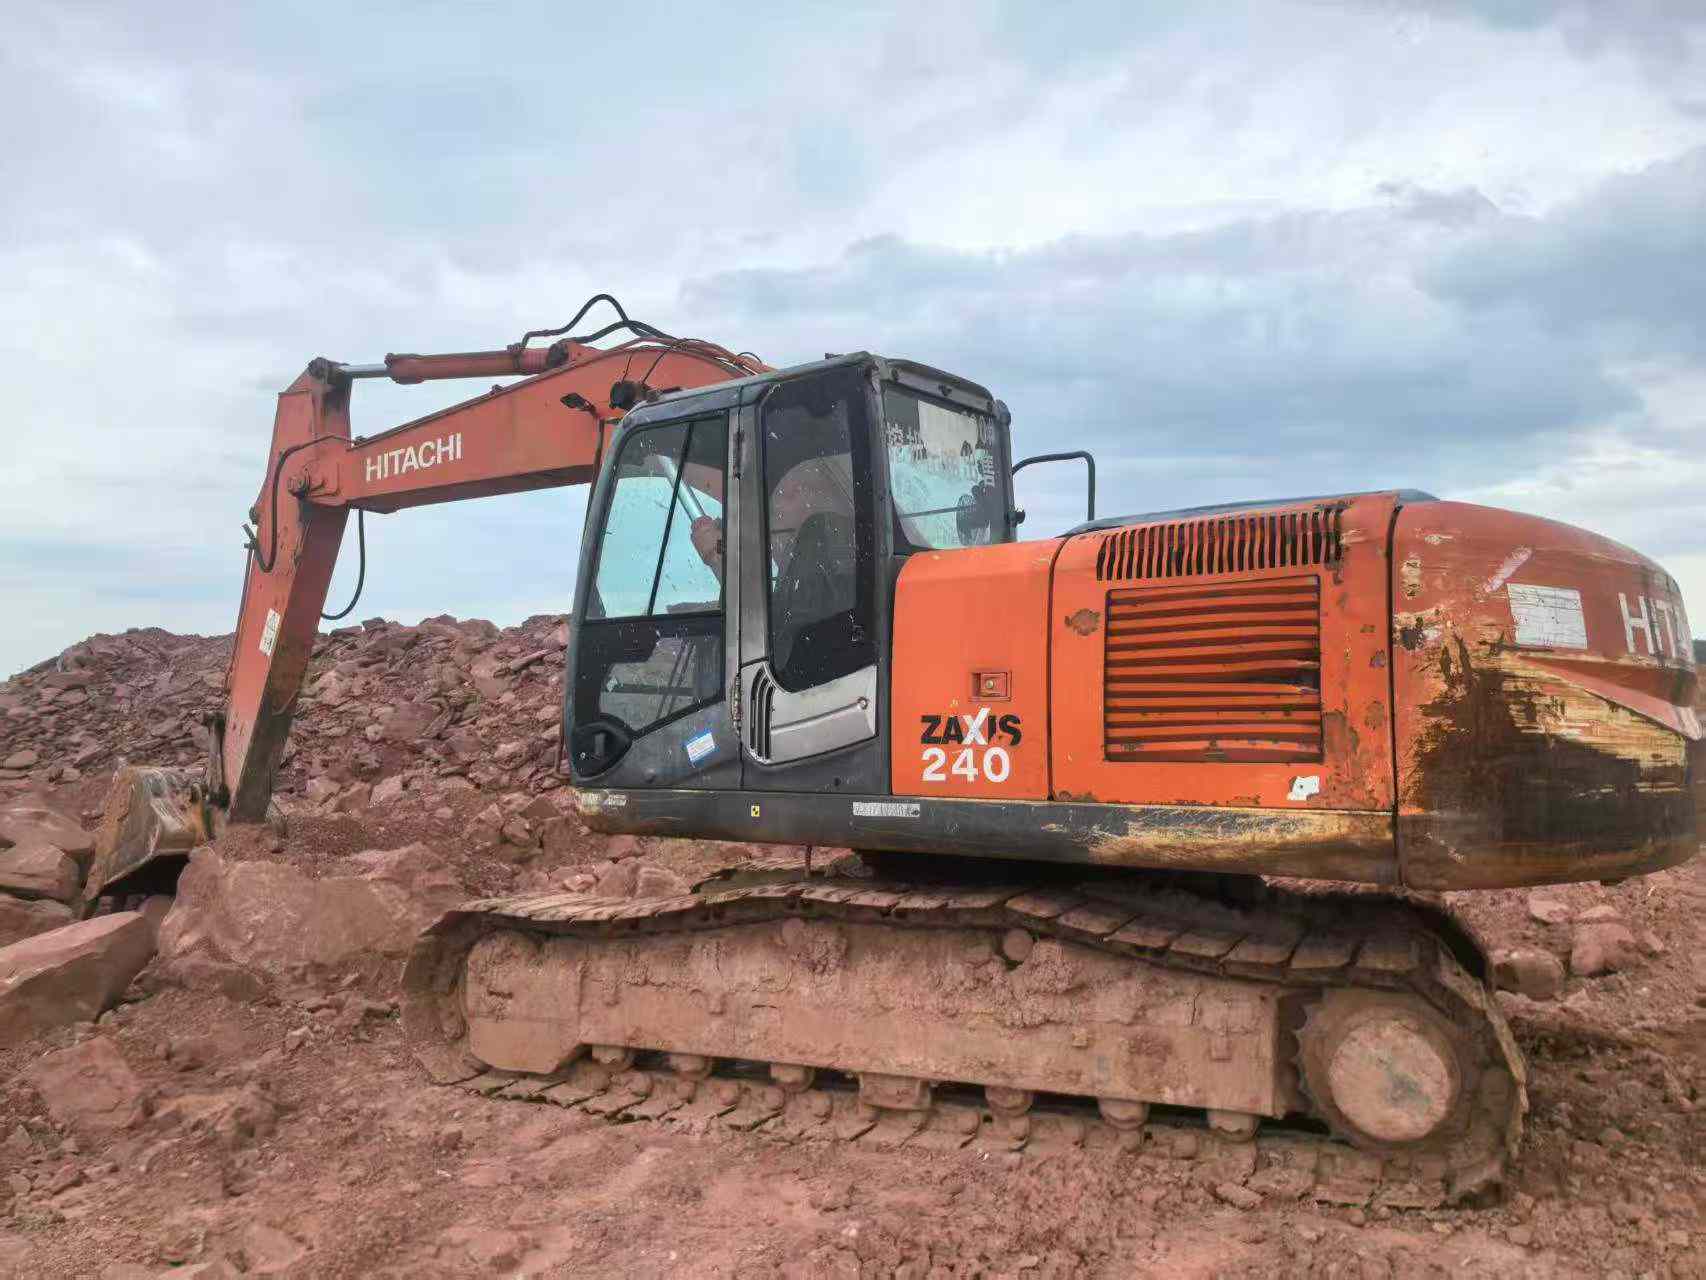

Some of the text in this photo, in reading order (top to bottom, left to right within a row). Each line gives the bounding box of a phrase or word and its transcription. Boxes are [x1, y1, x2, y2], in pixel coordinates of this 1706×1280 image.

[365, 432, 463, 482] HITACHI
[920, 706, 1023, 746] ZAXIS
[921, 746, 1010, 783] 240
